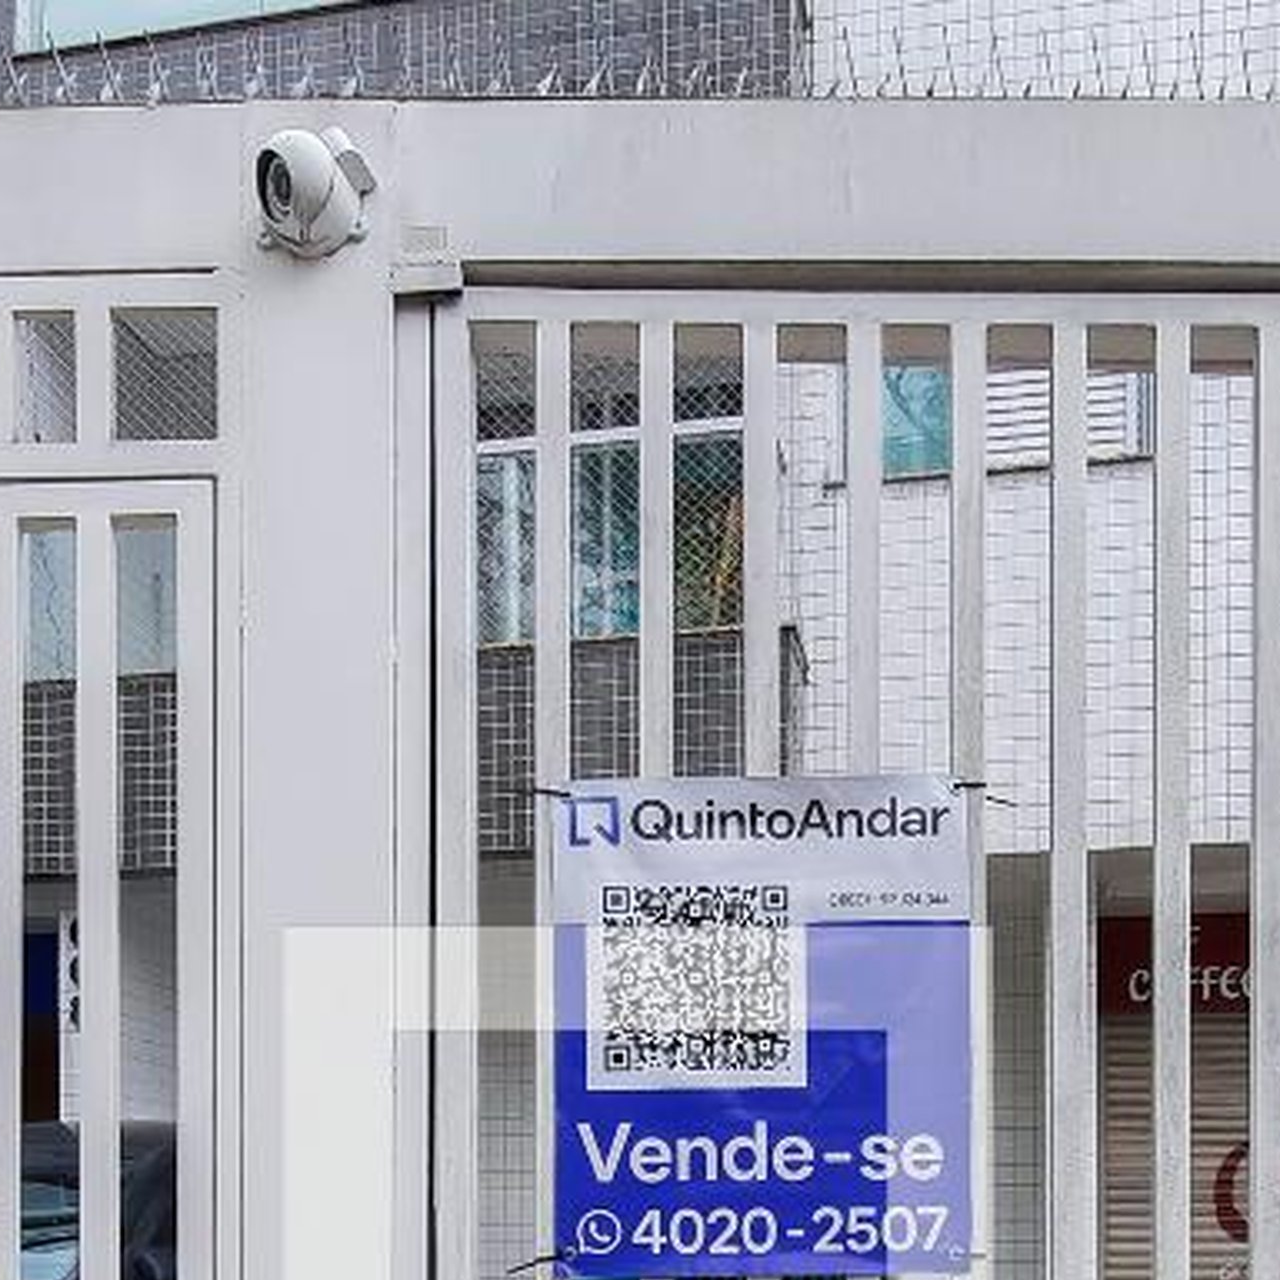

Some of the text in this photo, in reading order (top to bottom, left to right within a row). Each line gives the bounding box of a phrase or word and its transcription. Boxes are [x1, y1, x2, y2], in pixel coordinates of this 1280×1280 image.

[631, 797, 950, 842] QuintoAndar
[578, 1120, 945, 1183] Vende-se
[632, 1206, 949, 1256] 4020-2507
